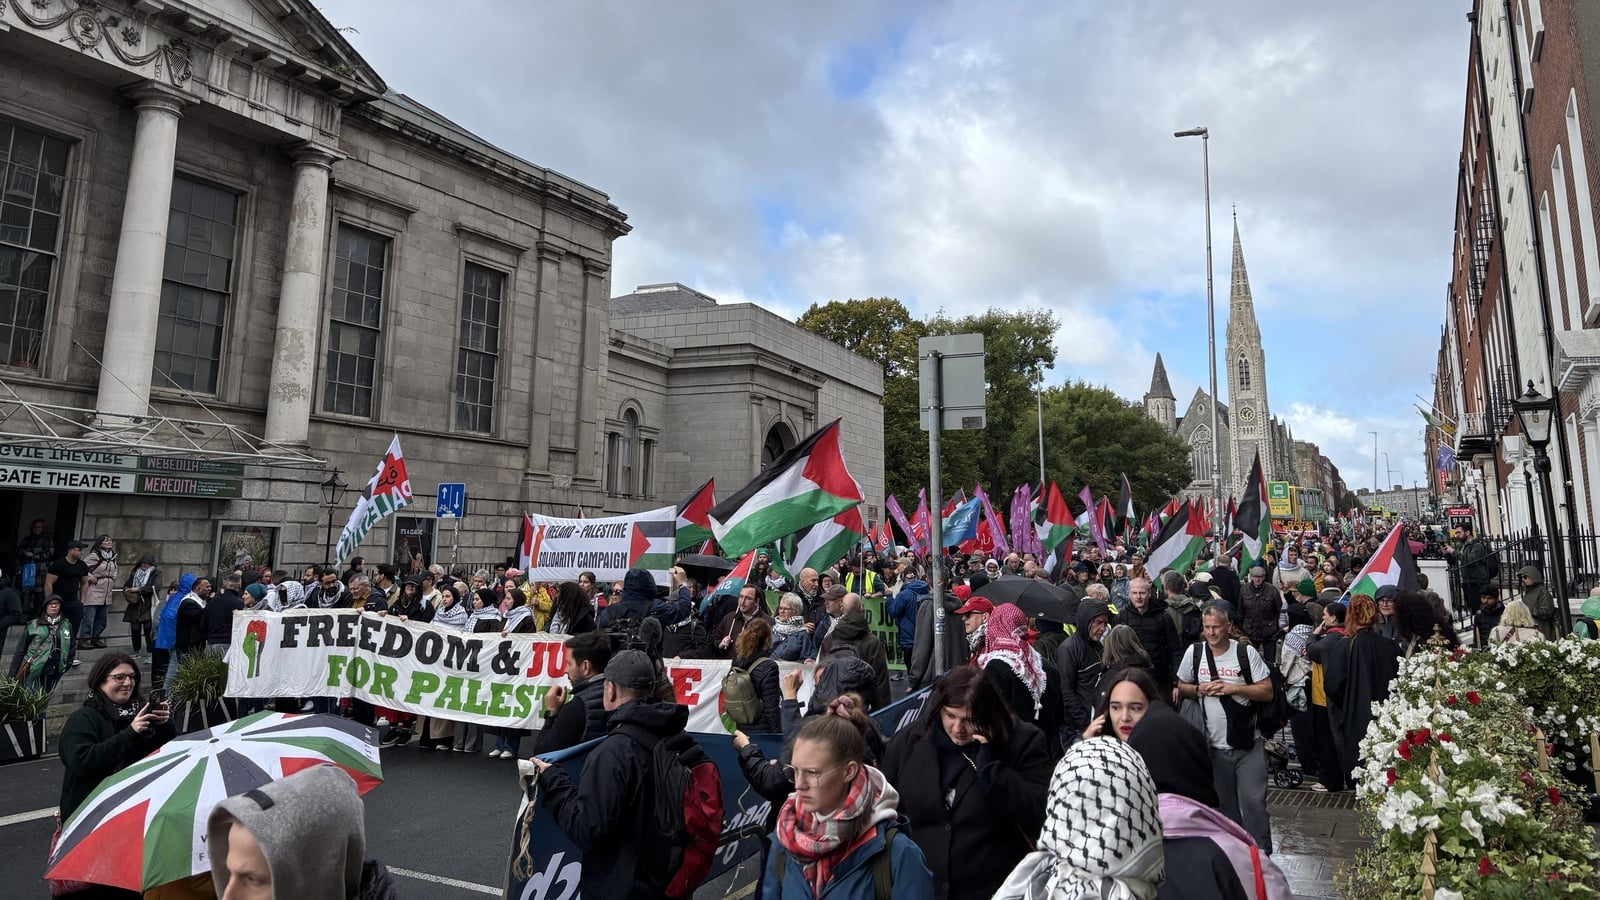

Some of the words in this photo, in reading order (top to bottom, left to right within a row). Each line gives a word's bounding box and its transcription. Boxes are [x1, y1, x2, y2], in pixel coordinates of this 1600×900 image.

[0, 468, 42, 485] GATE
[47, 471, 121, 489] THEATRE
[144, 477, 198, 494] MEREDITH
[545, 525, 576, 540] IRELAND
[580, 522, 628, 539] PALESTINE
[538, 551, 575, 569] SOLIDARITY
[577, 550, 628, 569] CAMPAIGN
[280, 614, 483, 673] FREEDOM
[491, 640, 521, 676] &
[327, 654, 398, 700] FOR
[404, 670, 574, 719] PALEST
